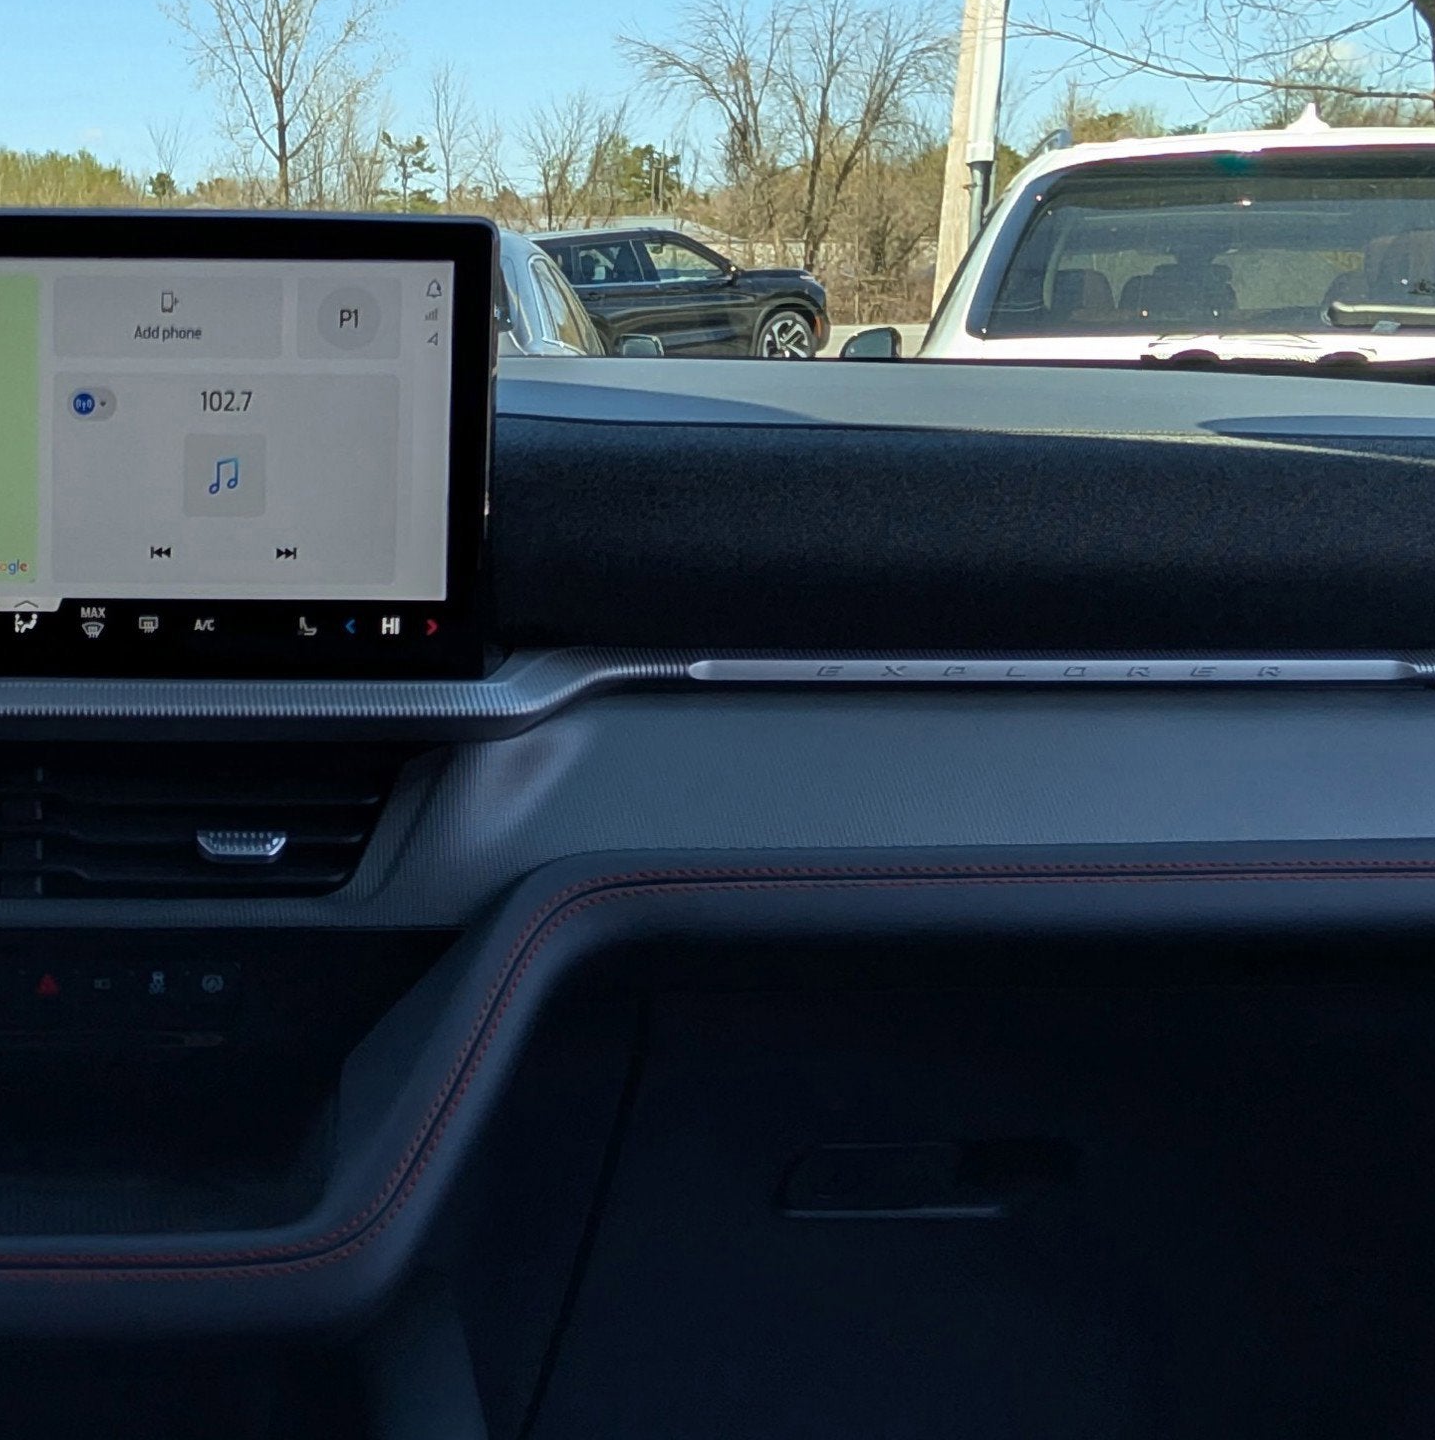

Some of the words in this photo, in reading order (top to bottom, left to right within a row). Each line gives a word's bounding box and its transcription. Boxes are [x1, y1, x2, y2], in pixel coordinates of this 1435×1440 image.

[338, 309, 359, 329] P1
[134, 325, 160, 340] Add
[162, 325, 203, 342] phone
[199, 391, 253, 412] 102.7
[80, 606, 107, 619] MAX
[194, 618, 216, 632] A/C
[382, 616, 401, 636] HI
[816, 665, 1283, 678] EXPLORER
